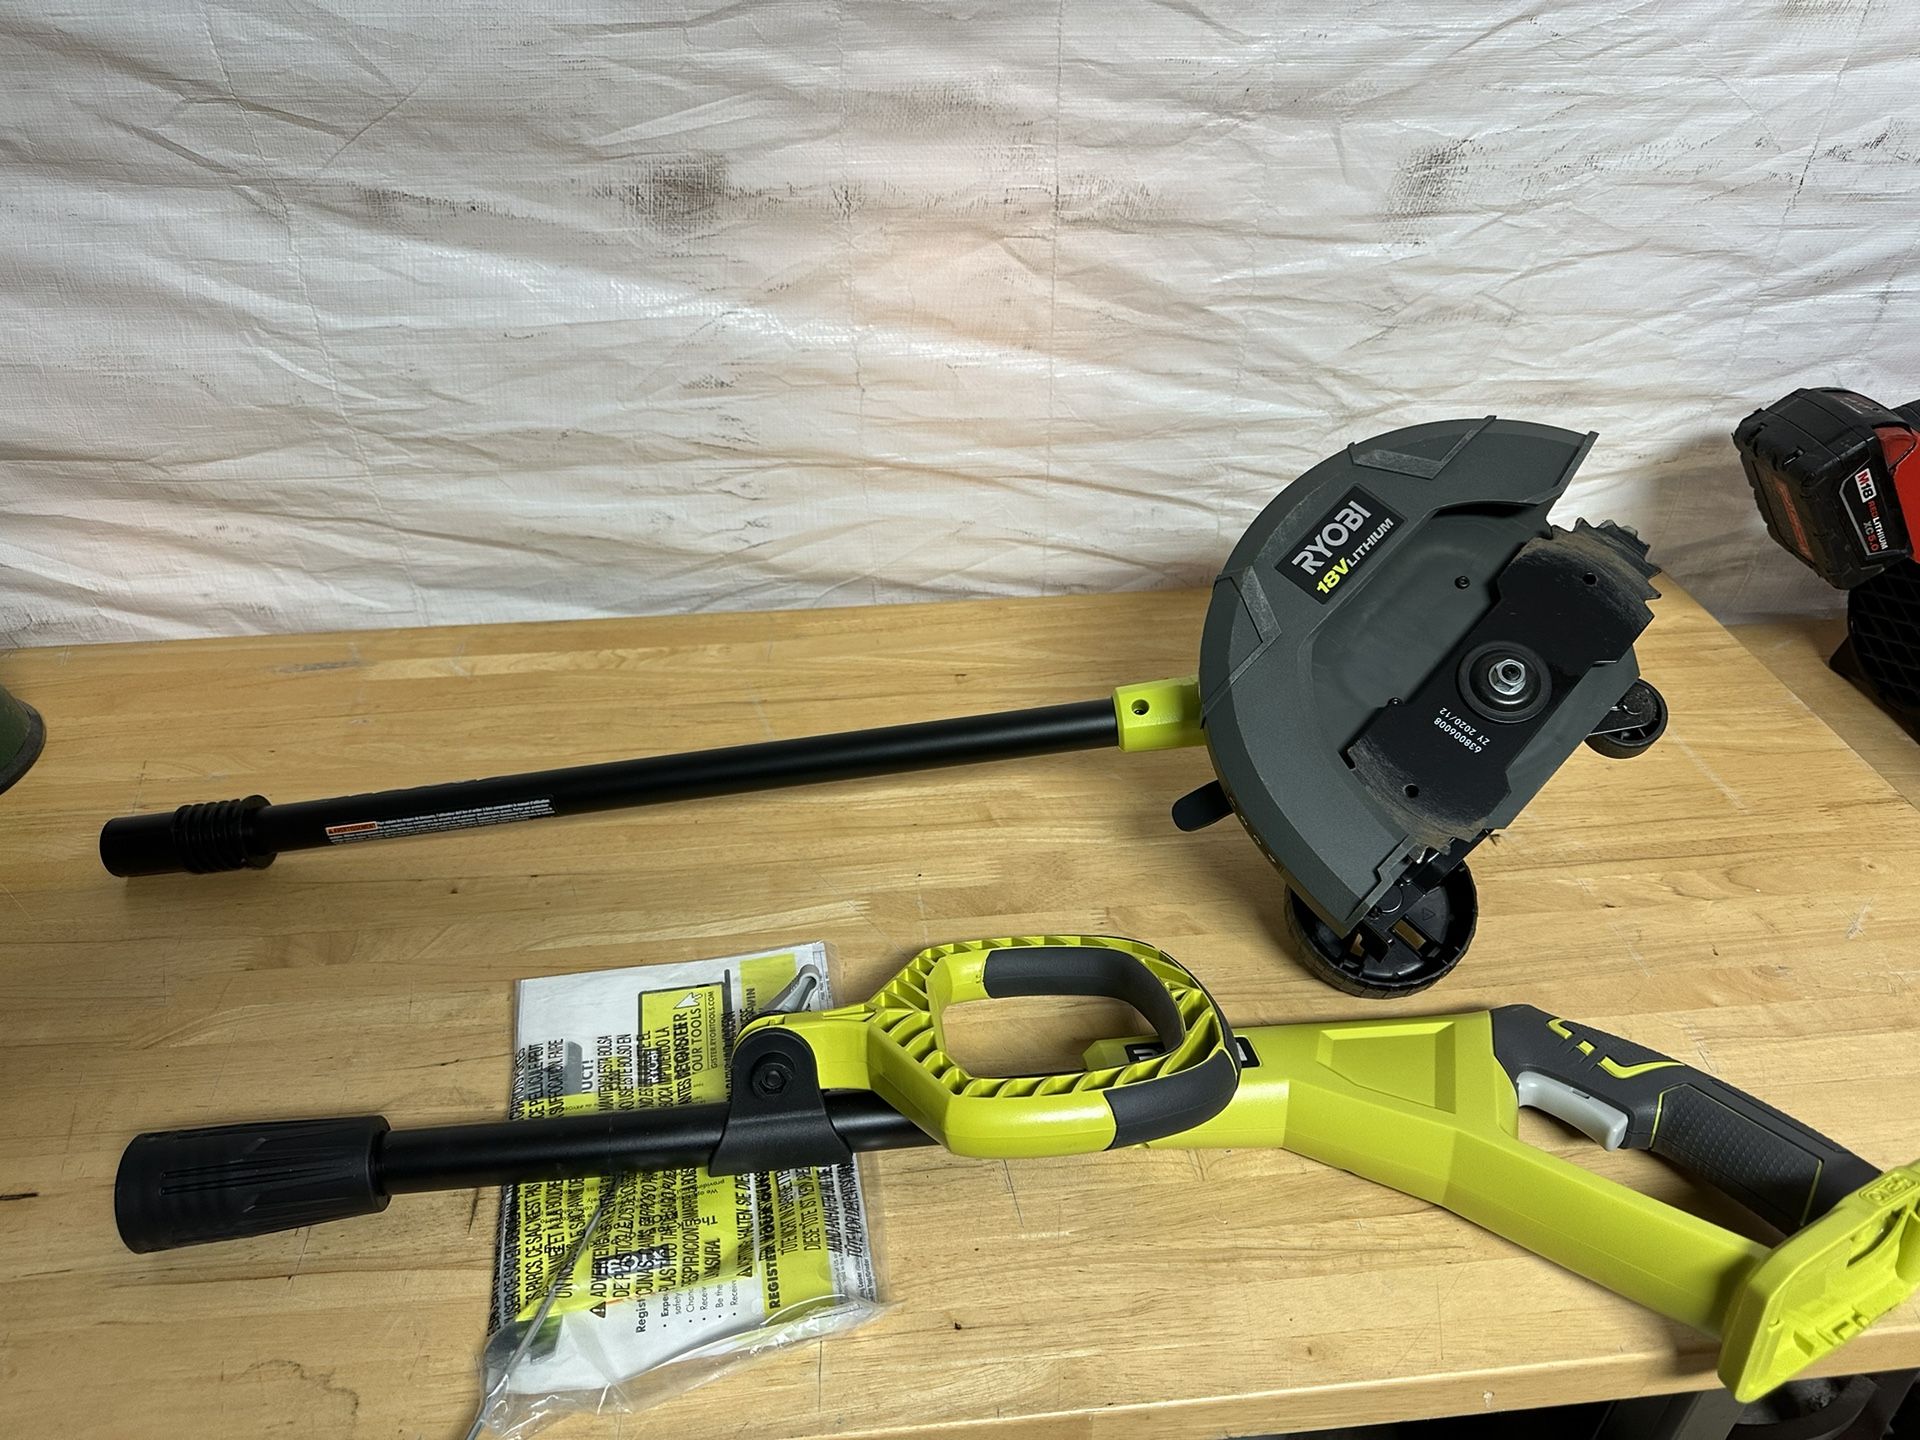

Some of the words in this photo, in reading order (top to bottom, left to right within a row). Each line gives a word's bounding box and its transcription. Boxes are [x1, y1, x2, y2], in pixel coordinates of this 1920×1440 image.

[1857, 470, 1876, 499] M18
[1291, 500, 1372, 576] RYOBI
[1439, 707, 1477, 736] 2020/12
[1433, 717, 1483, 754] 638006008
[1477, 735, 1491, 746] ZY
[656, 1027, 670, 1037] LA
[690, 1008, 703, 1045] TOOLS
[548, 1039, 563, 1059] FAIRE
[597, 1035, 612, 1056] BOLSA
[616, 1034, 631, 1044] EN
[617, 1045, 632, 1067] BOLSO
[677, 1079, 692, 1105] ANTES
[525, 1224, 542, 1243] SAC
[525, 1244, 543, 1258] CE
[525, 1258, 543, 1291] PARCS.
